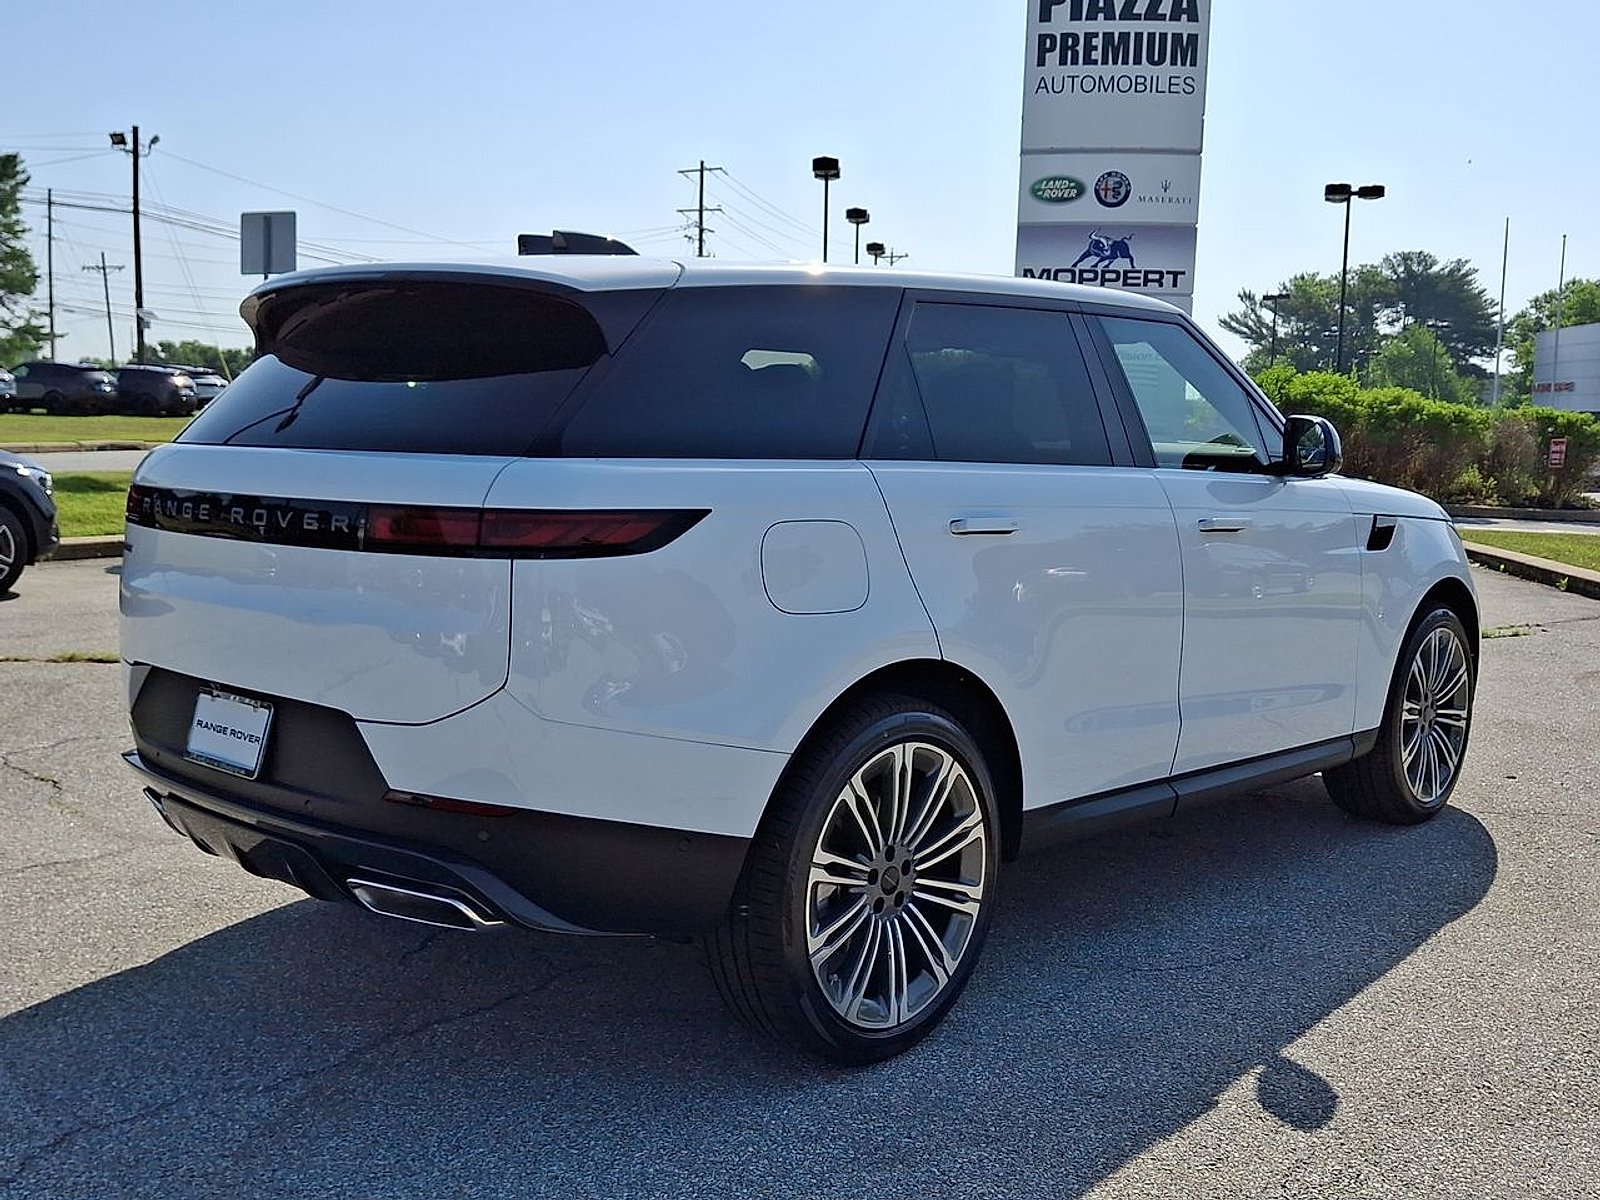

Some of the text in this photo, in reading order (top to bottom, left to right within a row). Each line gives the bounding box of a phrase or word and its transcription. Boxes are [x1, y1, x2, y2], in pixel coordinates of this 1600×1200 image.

[1038, 0, 1199, 23] PIAZZA
[1036, 32, 1199, 67] PREMIUM
[1034, 74, 1196, 94] AUTOMOBILES
[1041, 180, 1069, 189] LAND
[1043, 189, 1078, 199] ROVER
[1022, 268, 1186, 288] MOPPERT
[142, 498, 350, 532] RANGE ROVER
[196, 719, 261, 744] RANGE ROVER
